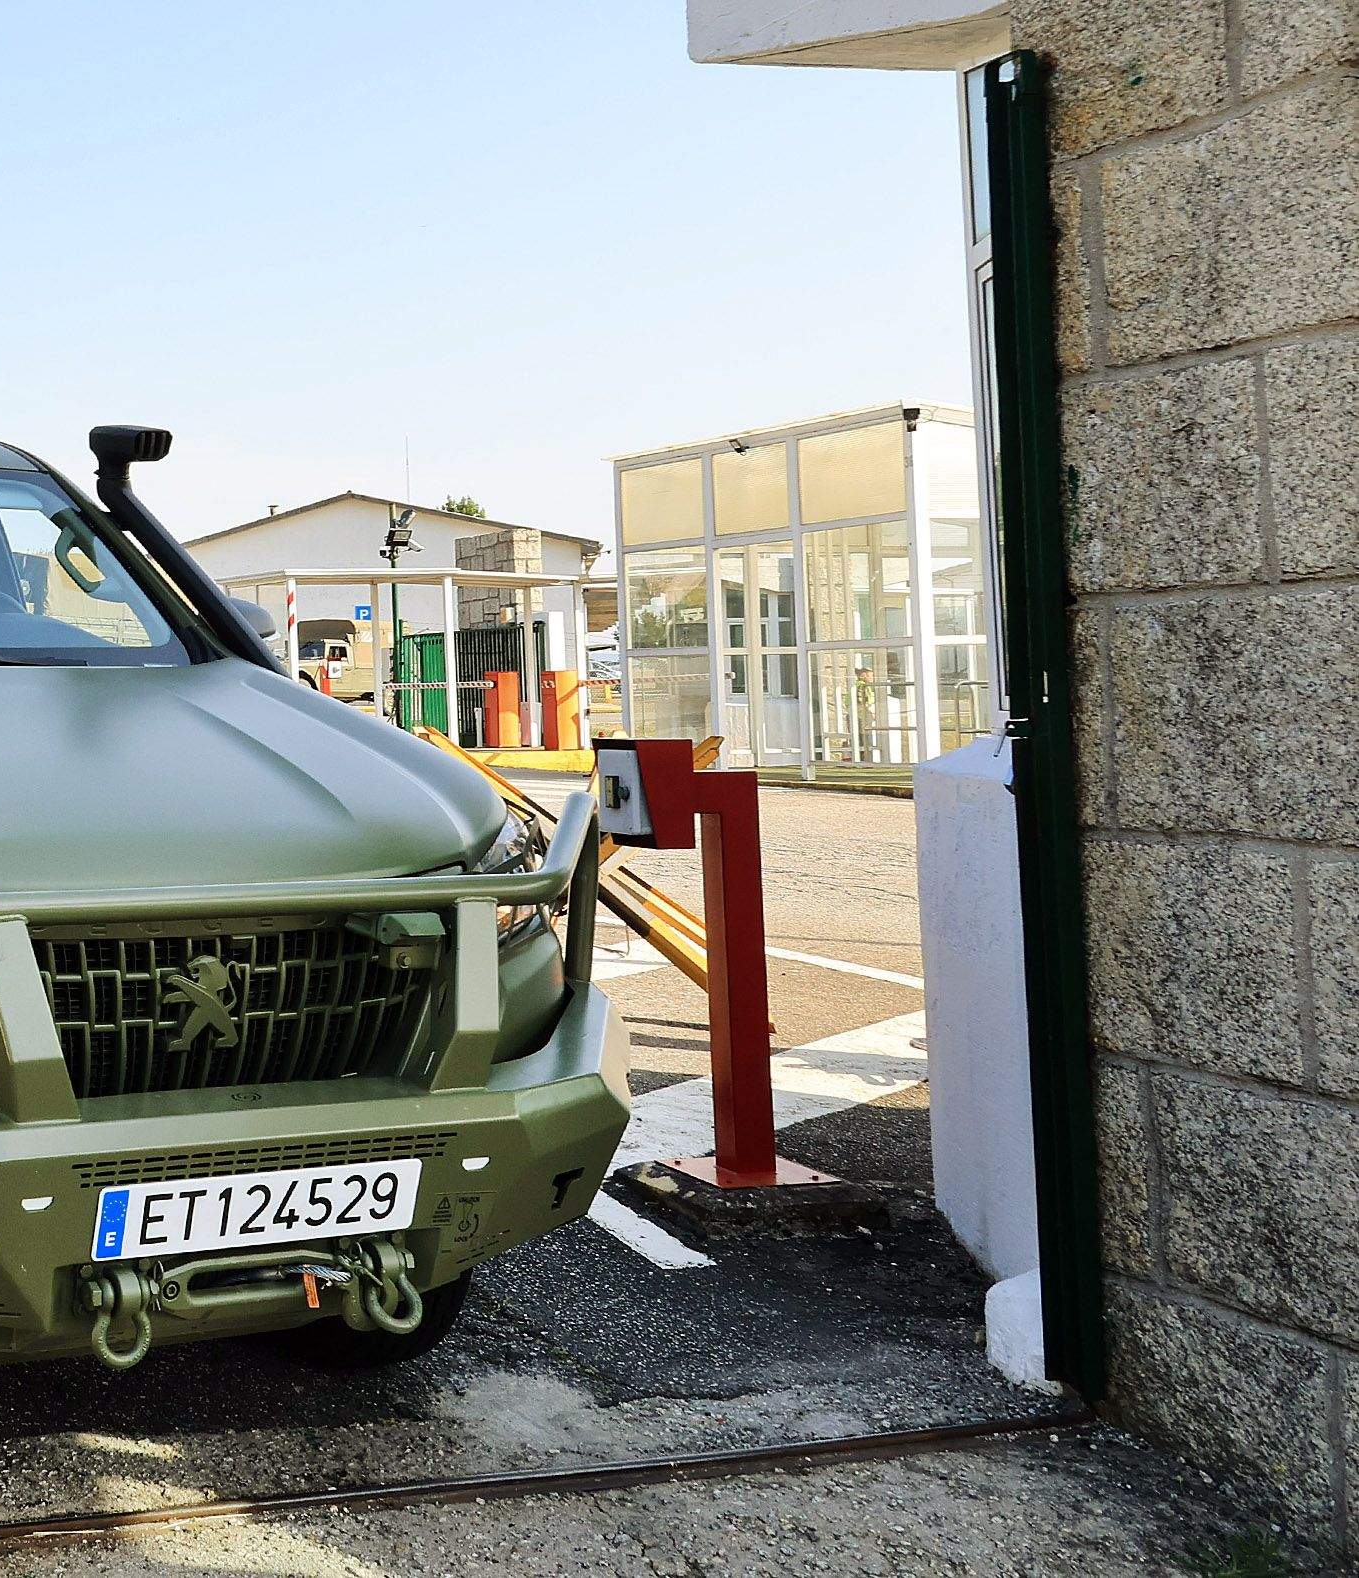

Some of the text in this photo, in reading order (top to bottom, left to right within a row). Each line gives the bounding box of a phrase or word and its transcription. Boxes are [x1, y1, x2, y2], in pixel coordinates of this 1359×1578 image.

[359, 609, 369, 620] P
[140, 1172, 399, 1246] ET124529
[104, 1231, 117, 1248] E
